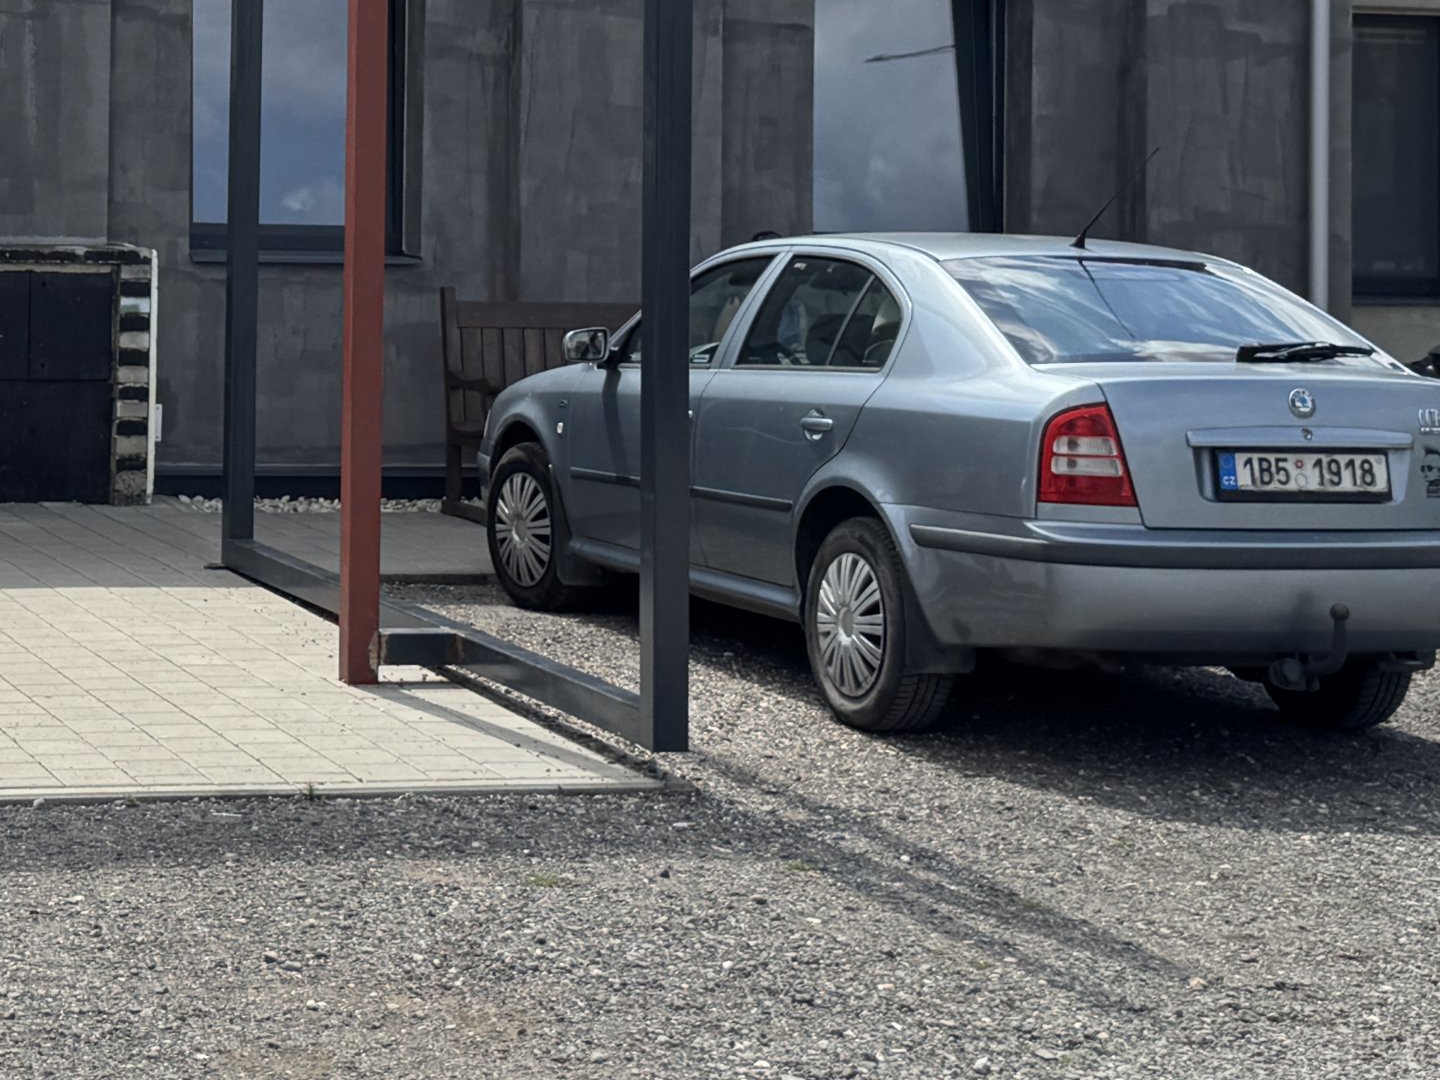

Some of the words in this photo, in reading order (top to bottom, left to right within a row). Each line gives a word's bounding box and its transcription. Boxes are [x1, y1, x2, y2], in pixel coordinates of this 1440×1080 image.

[1222, 476, 1236, 486] CZ
[1243, 456, 1291, 487] 1B5
[1312, 457, 1377, 488] 1918
